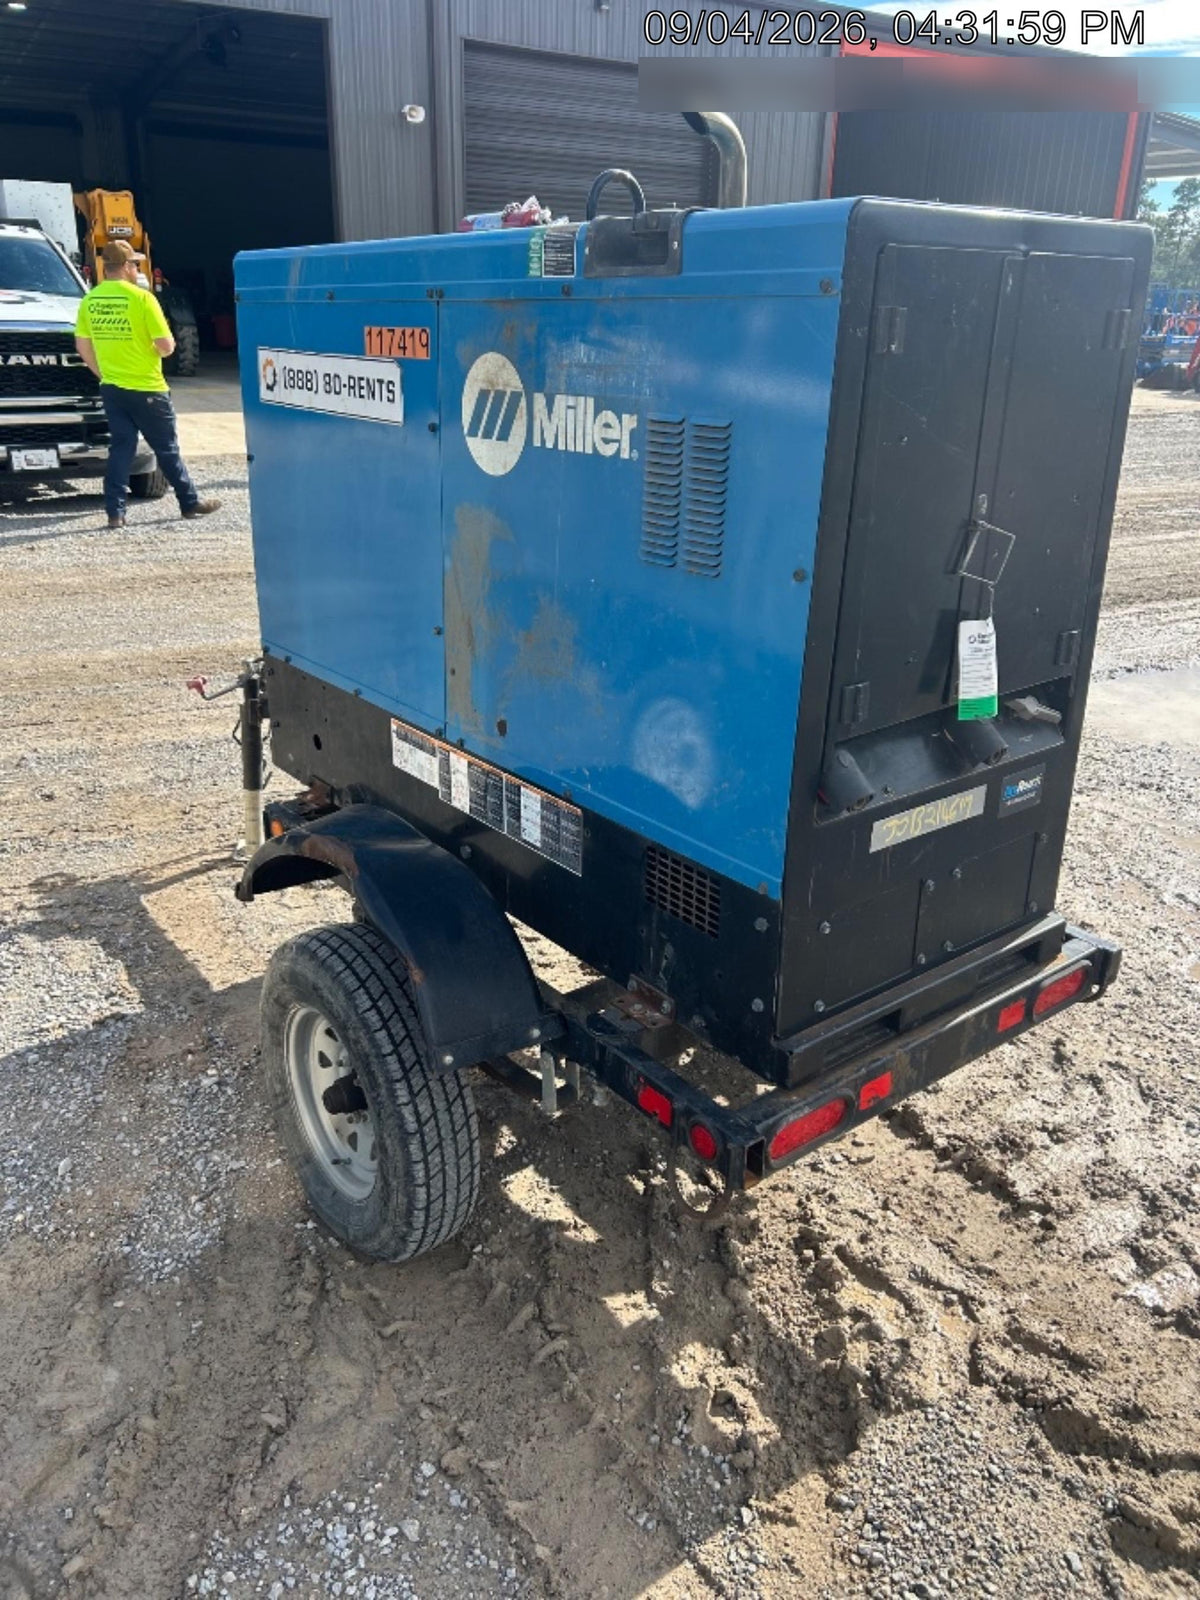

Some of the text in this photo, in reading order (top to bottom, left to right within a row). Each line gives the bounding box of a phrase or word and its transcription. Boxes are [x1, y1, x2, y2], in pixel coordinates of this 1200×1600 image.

[0, 355, 57, 365] AM
[366, 327, 429, 358] 117419
[283, 365, 396, 404] (888) 80-RENTS
[533, 393, 637, 460] Miller
